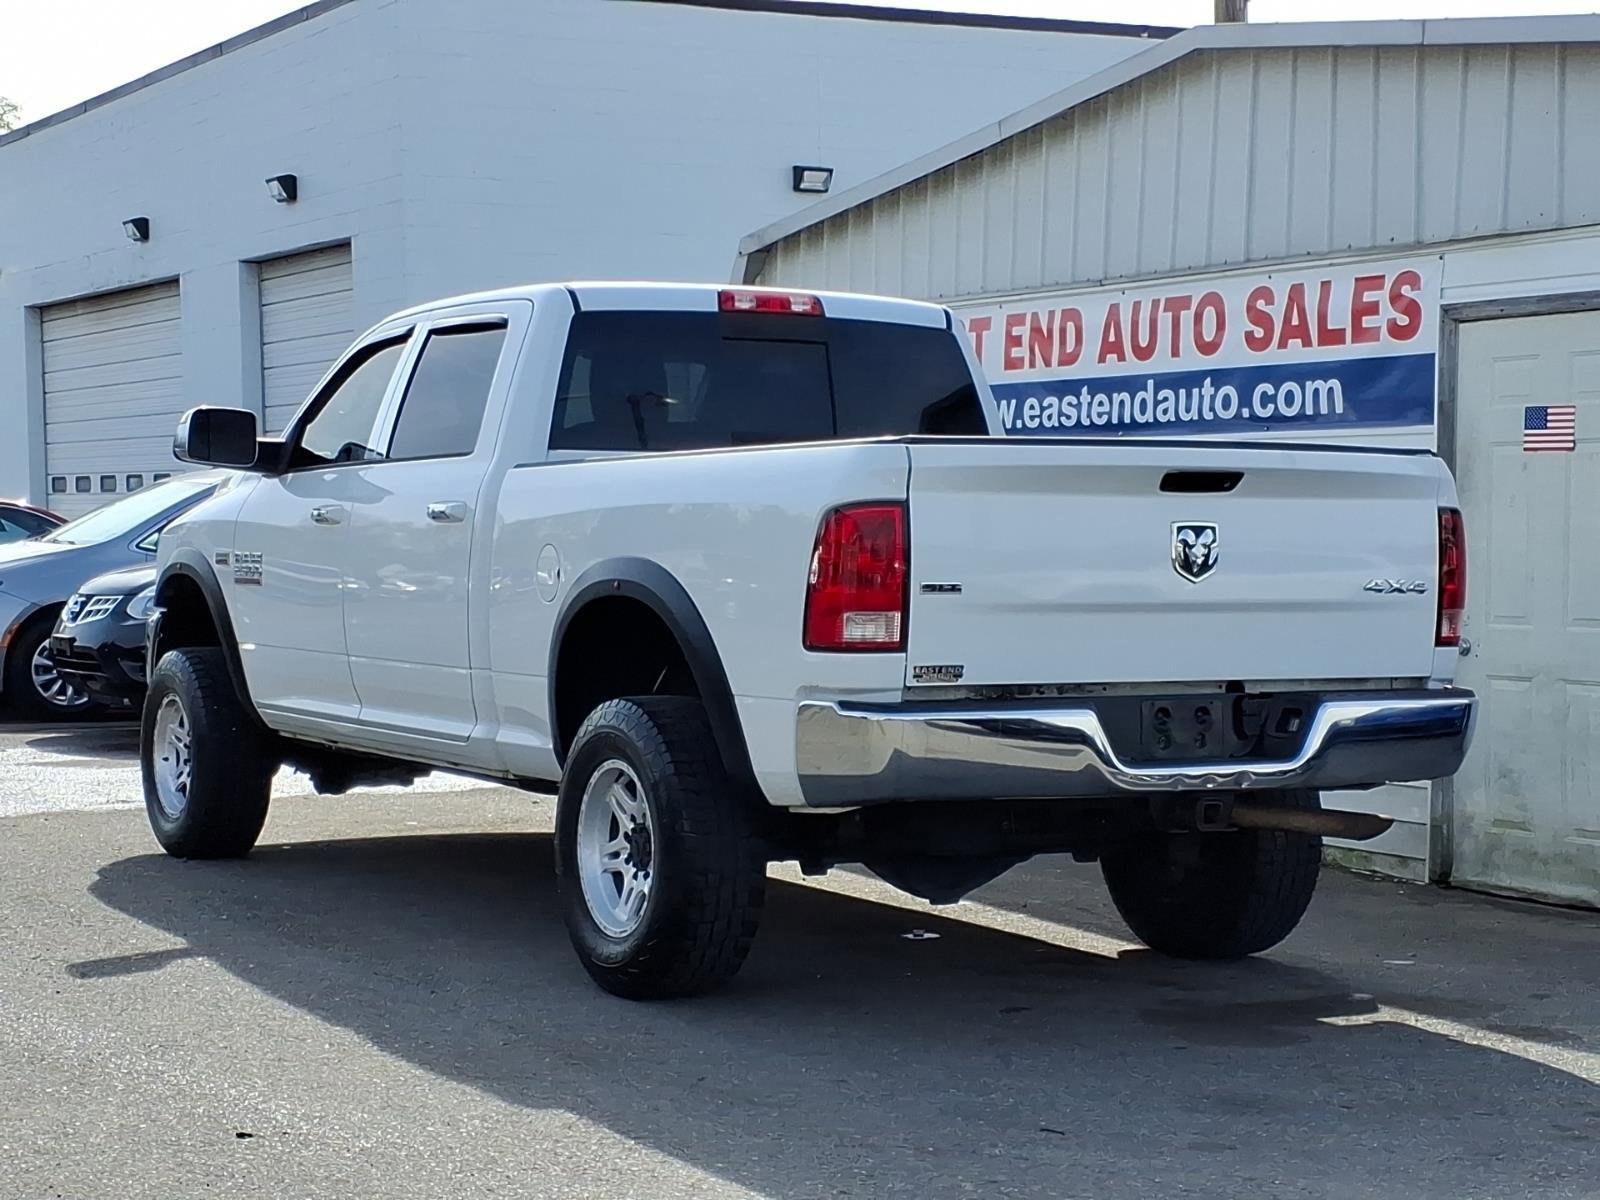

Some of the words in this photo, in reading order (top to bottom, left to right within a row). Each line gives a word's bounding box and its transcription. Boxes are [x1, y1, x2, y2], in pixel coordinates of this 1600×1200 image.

[968, 316, 993, 367] T
[1003, 307, 1084, 371] END
[1097, 291, 1226, 364] AUTO
[1244, 270, 1422, 352] SALES
[998, 376, 1344, 430] w.eastendauto.com
[915, 666, 940, 674] EAST
[941, 666, 962, 674] END
